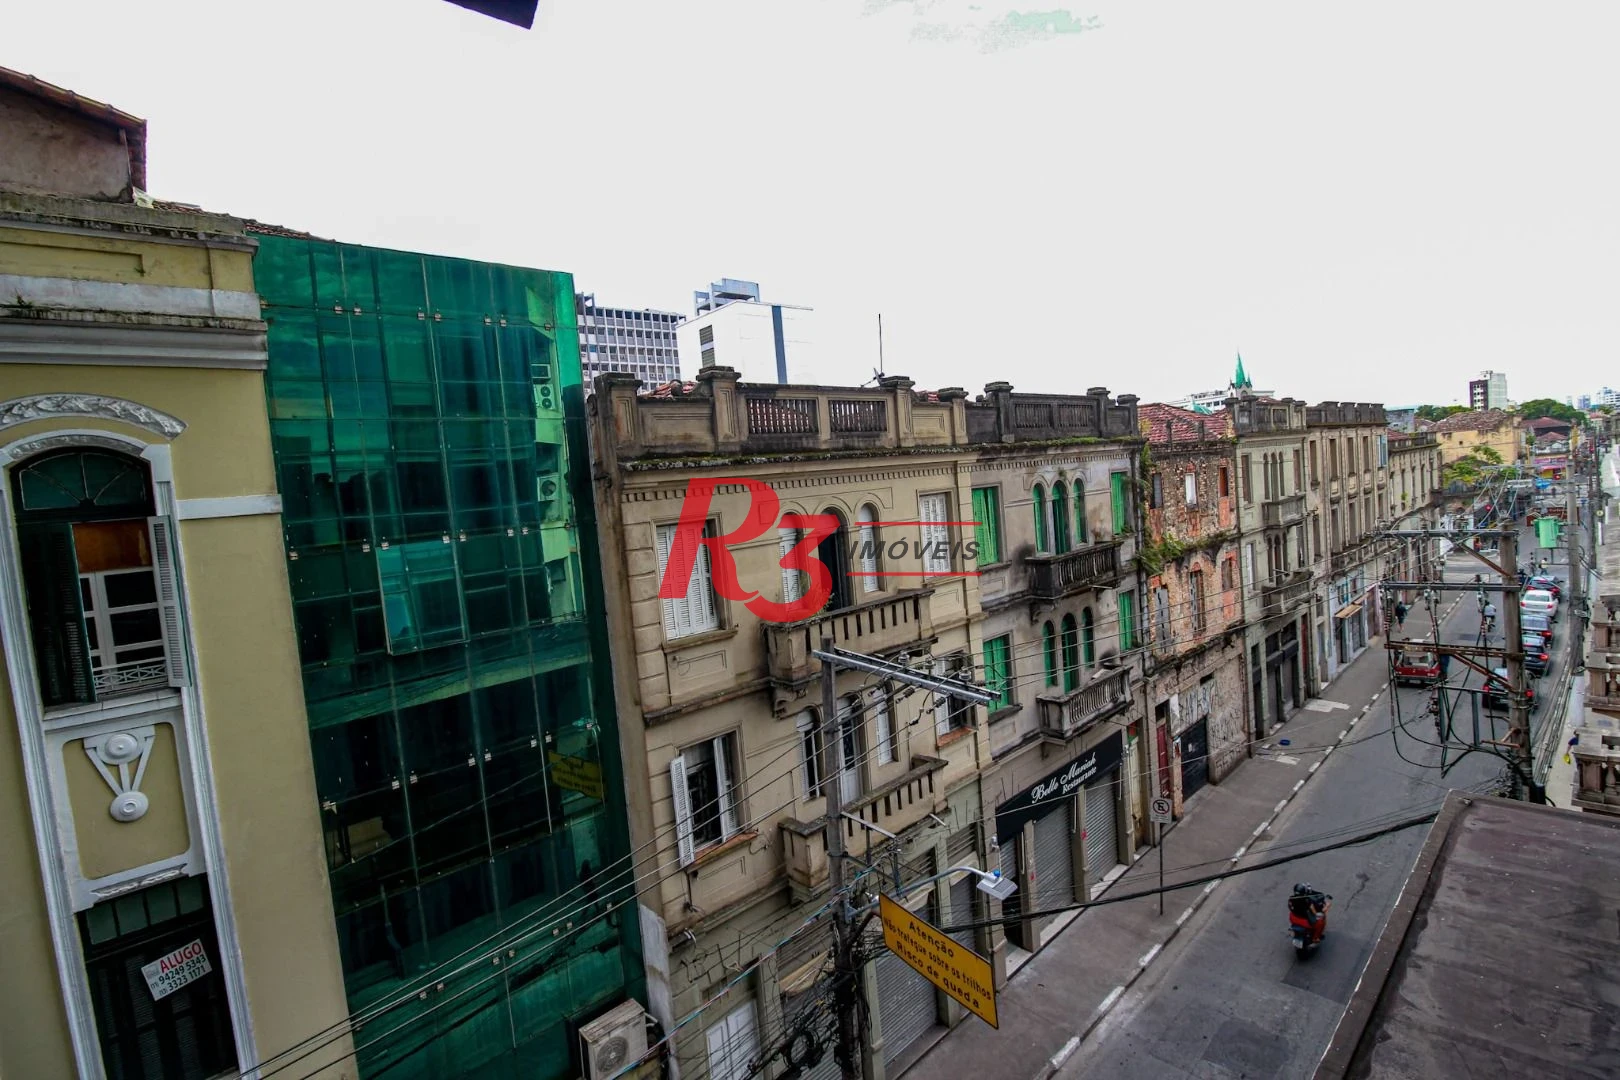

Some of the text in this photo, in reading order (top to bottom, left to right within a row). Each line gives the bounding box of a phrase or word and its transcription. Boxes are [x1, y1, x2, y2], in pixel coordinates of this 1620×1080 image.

[1031, 777, 1058, 803] Belle
[1062, 767, 1096, 794] Restaurante
[909, 921, 954, 958] Atenção
[159, 965, 185, 984] 94249
[186, 954, 206, 971] 5343
[160, 943, 201, 973] ALUGO
[896, 941, 923, 968] Risco
[927, 965, 939, 979] de
[167, 975, 187, 991] 3323
[189, 965, 206, 979] 1171
[928, 951, 949, 971] sobre
[951, 967, 961, 979] os
[962, 972, 991, 1000] trilhos
